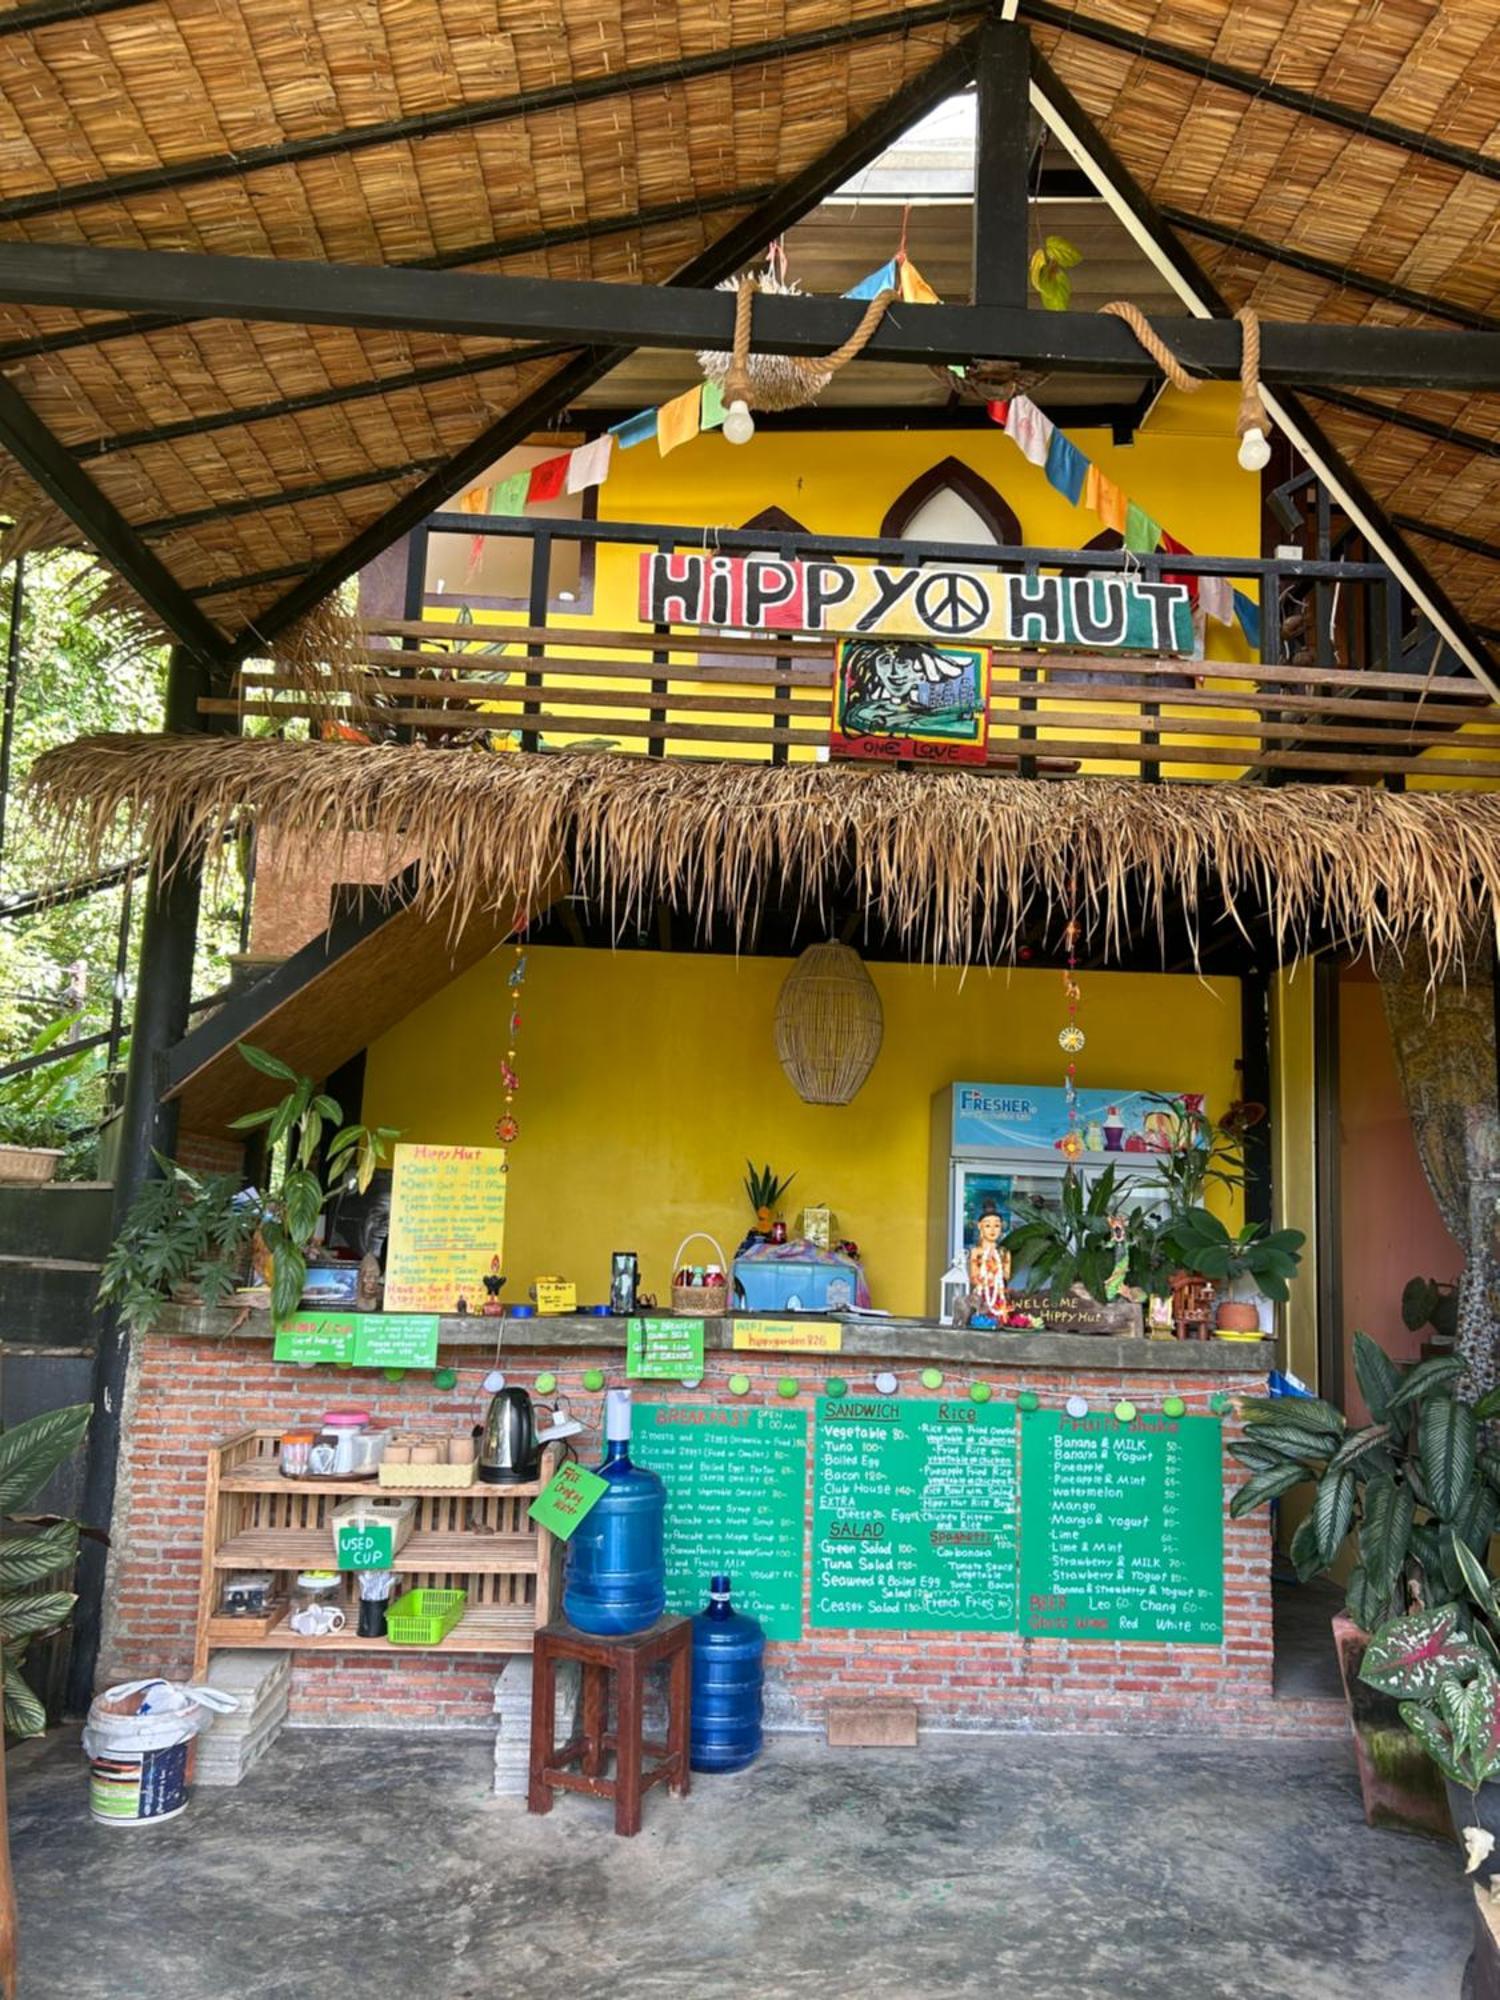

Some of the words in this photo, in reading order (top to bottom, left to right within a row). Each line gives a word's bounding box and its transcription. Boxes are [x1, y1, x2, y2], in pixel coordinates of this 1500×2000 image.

[1007, 575, 1190, 651] HUT
[864, 742, 901, 756] ONE
[912, 742, 961, 759] LOVE
[960, 1090, 1031, 1113] FRESHER
[825, 1402, 900, 1418] SANDWICH
[938, 1403, 977, 1420] Rice
[824, 1425, 887, 1441] Vegetable
[824, 1441, 854, 1453] Tuna
[1054, 1435, 1098, 1450] Banana
[1113, 1438, 1147, 1450] MILK
[824, 1454, 858, 1467] Boiled
[861, 1455, 880, 1469] Egg
[1054, 1448, 1098, 1461] Banana
[1114, 1450, 1153, 1465] Yogurt
[824, 1468, 860, 1481] Bacon
[1054, 1461, 1104, 1473] Pineapple
[1116, 1475, 1146, 1486] Mint
[824, 1482, 850, 1495] Club
[854, 1483, 891, 1495] House
[820, 1496, 856, 1509] EXTRA
[1051, 1501, 1096, 1514] Mango
[829, 1522, 885, 1537] SALAD
[1051, 1514, 1094, 1528] Mango
[1108, 1515, 1150, 1531] Yogurt
[1051, 1529, 1079, 1541] Lime
[341, 1537, 374, 1550] USED
[820, 1539, 857, 1554] Green
[860, 1540, 893, 1555] Salad
[936, 1545, 992, 1557] Carbonara
[1051, 1541, 1078, 1553] Lime
[1092, 1541, 1122, 1553] Mint
[353, 1550, 383, 1565] CUP
[822, 1557, 853, 1570] Tuna
[859, 1557, 893, 1571] Salad
[1052, 1554, 1113, 1567] Strawberry
[1131, 1557, 1161, 1568] MILK
[822, 1572, 875, 1588] Seaweed
[920, 1576, 941, 1589] Egg
[1053, 1569, 1114, 1581] Strawberry
[1131, 1571, 1167, 1584] Yogurt
[881, 1587, 911, 1599] Salad
[868, 1600, 900, 1614] Salad
[966, 1595, 994, 1611] Fries
[1088, 1596, 1111, 1611] Leo
[1140, 1599, 1176, 1615] Chang
[1119, 1615, 1138, 1631] Red
[1156, 1617, 1192, 1633] White
